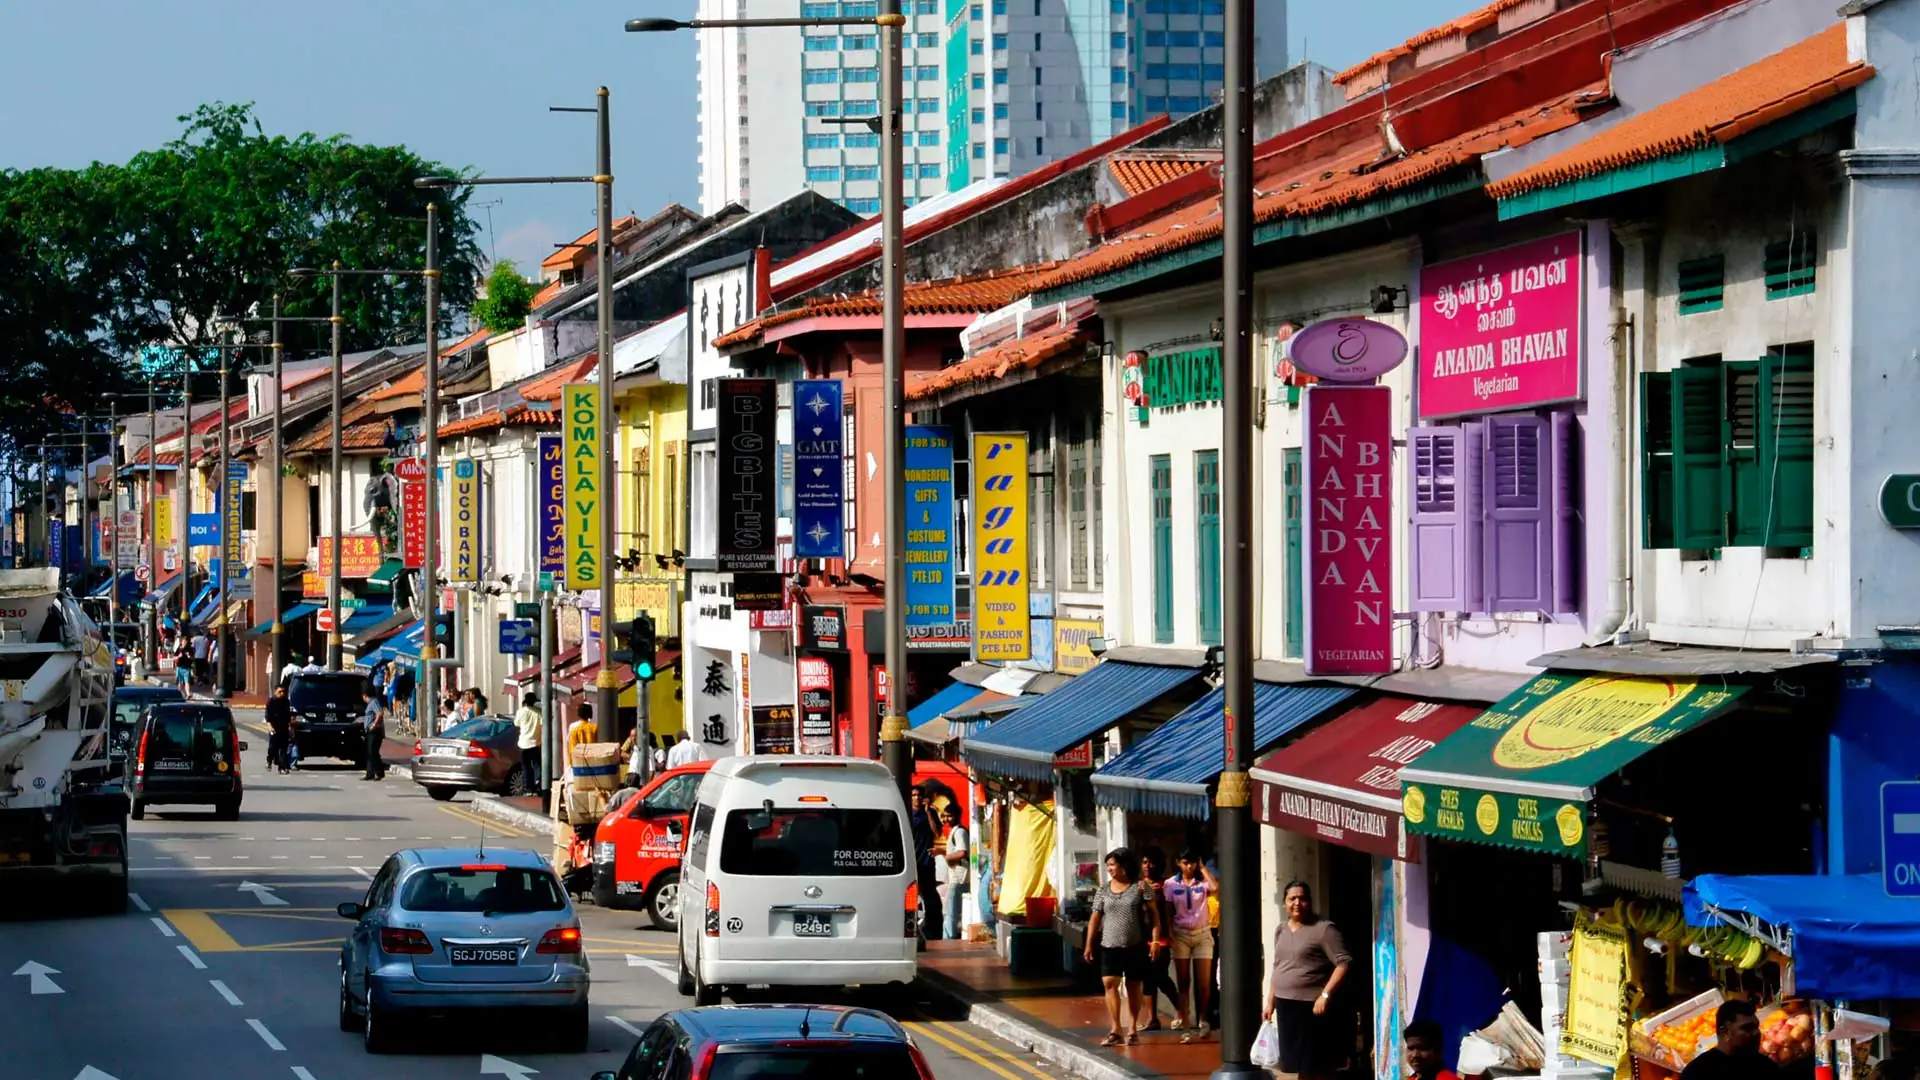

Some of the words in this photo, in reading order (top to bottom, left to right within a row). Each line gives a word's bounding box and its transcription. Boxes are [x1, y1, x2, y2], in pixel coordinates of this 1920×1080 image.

[1434, 264, 1503, 319] ஆனந்த
[1511, 246, 1568, 294] பவன்
[1477, 300, 1516, 332] சைவம்
[1433, 342, 1495, 378] ANANDA
[1502, 328, 1568, 367] BHAVAN
[1473, 373, 1519, 400] Vegetarian
[732, 396, 763, 452] BIG
[573, 393, 595, 492] KOMALA
[797, 440, 839, 453] GMT
[459, 484, 470, 522] UCO
[732, 456, 763, 549] BITES
[915, 489, 938, 502] GIFTS
[1319, 402, 1346, 585] ANANDA
[406, 484, 416, 546] COSTUME
[923, 510, 930, 522] &
[977, 443, 1020, 586] ragam
[576, 501, 595, 582] VILAS
[908, 530, 946, 542] COSTUME
[1354, 442, 1383, 625] BHAVAN
[459, 526, 470, 578] BANK
[905, 551, 948, 564] JEWELLERY
[912, 570, 926, 582] PTE
[928, 570, 942, 582] LTD
[913, 605, 930, 615] FOR
[986, 603, 1016, 612] VIDEO
[980, 630, 1023, 640] FASHION
[981, 644, 1000, 653] PTE
[1002, 644, 1022, 653] LTD
[1318, 650, 1384, 661] VEGETARIAN
[801, 662, 828, 675] DINING
[1226, 715, 1236, 764] D12
[1440, 788, 1460, 810] SPICES
[1518, 798, 1538, 820] SPICES
[1280, 792, 1310, 819] ANANDA
[1310, 798, 1340, 826] BHAVAN
[1341, 806, 1387, 838] VEGETARIAN
[1437, 808, 1464, 832] MASALAS
[1512, 819, 1544, 842] MASALAS
[834, 850, 852, 860] FOR
[854, 850, 894, 860] BOOKING
[728, 919, 742, 928] 70
[794, 923, 831, 933] 8249C
[806, 914, 820, 924] PA
[454, 950, 516, 960] SGJ7058C
